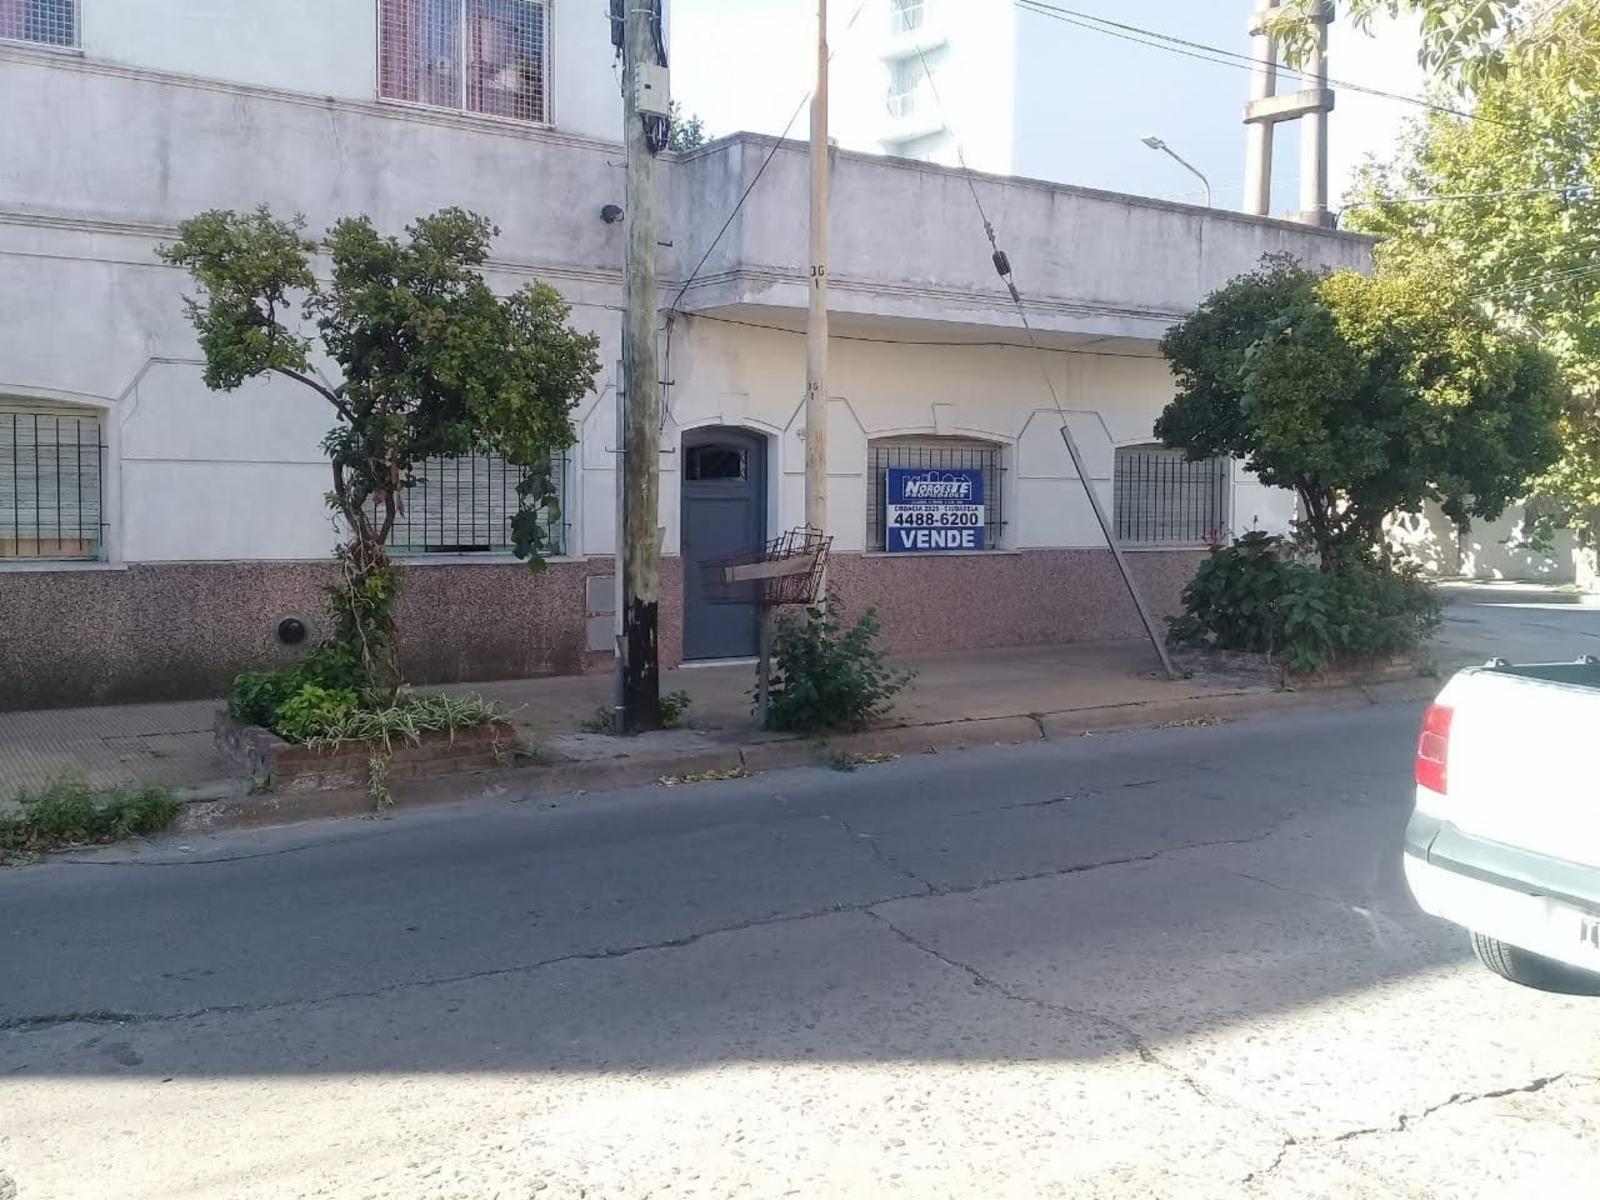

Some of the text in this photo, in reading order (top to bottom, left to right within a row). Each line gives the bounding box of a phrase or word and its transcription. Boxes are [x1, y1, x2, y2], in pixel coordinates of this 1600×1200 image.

[905, 480, 970, 495] NOROESTE
[894, 513, 978, 526] 4488-6200
[900, 529, 975, 548] VENDE
